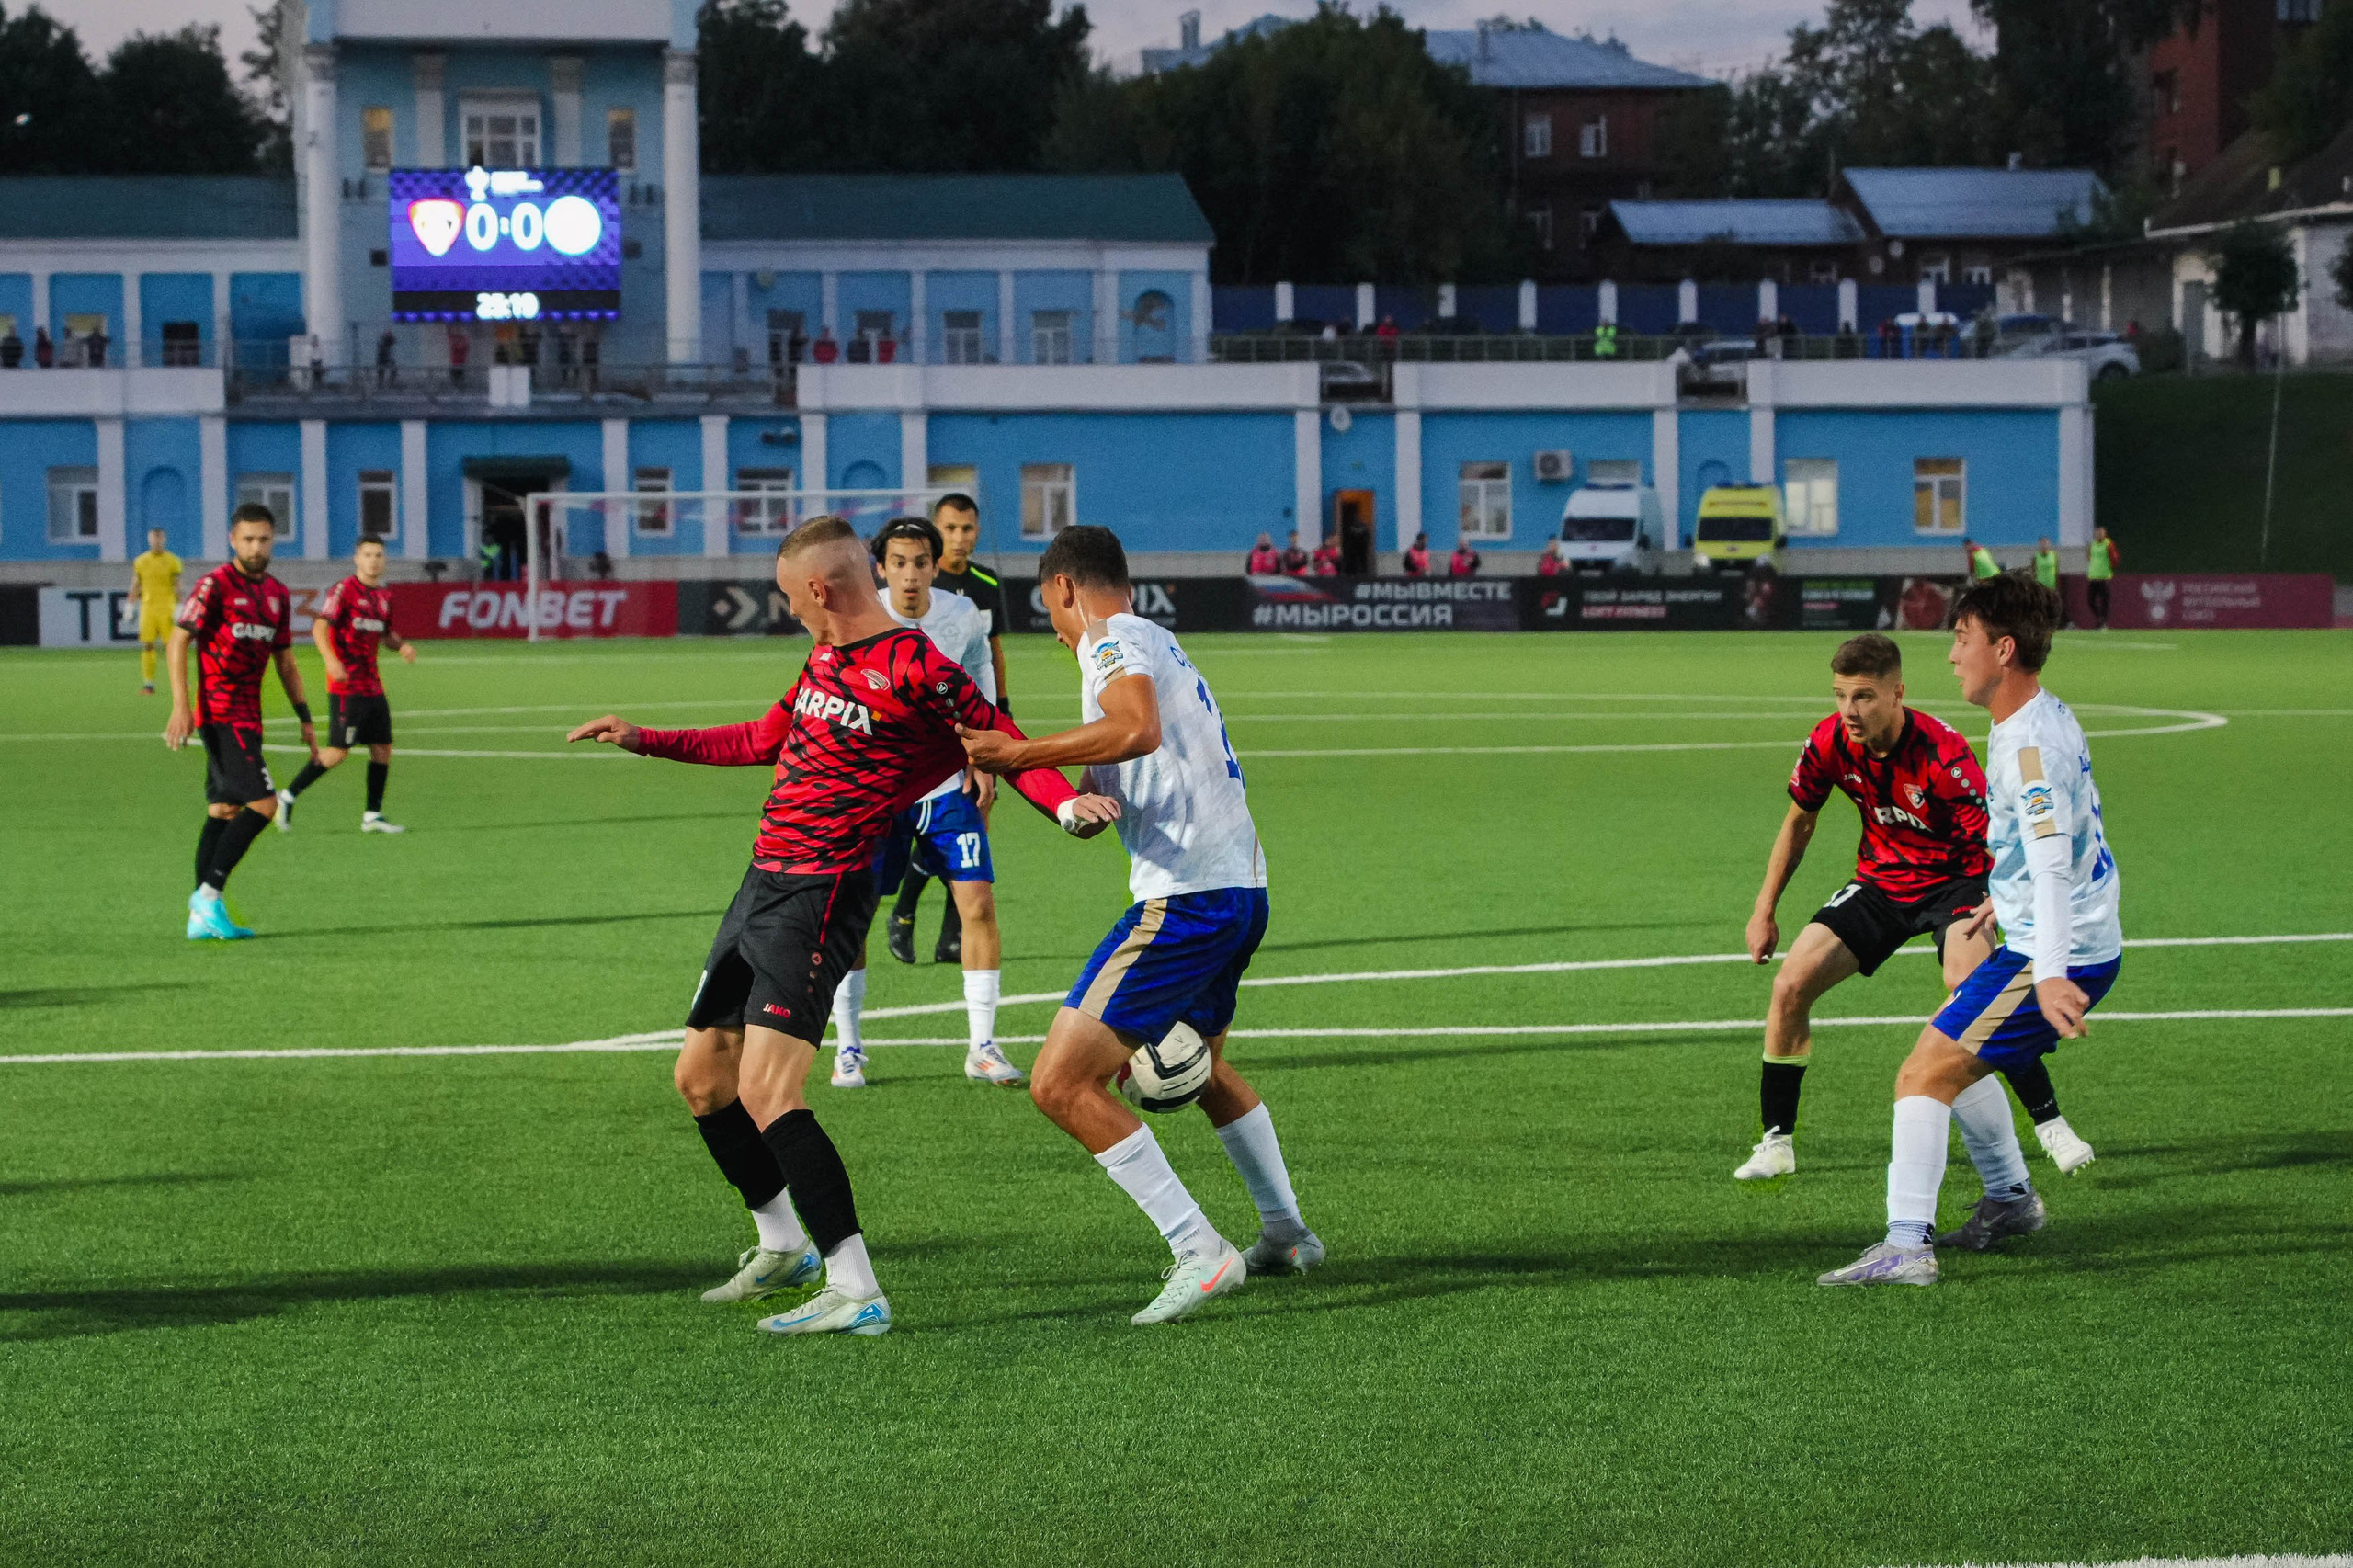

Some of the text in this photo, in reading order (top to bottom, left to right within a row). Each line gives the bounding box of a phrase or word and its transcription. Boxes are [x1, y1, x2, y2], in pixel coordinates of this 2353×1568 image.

[1354, 581, 1512, 600] #МЫВМЕСТЕ
[438, 590, 627, 629] FONBET
[1252, 603, 1453, 626] #МЫРОССИЯ
[956, 831, 981, 869] 17
[762, 1002, 791, 1018] JAKO
